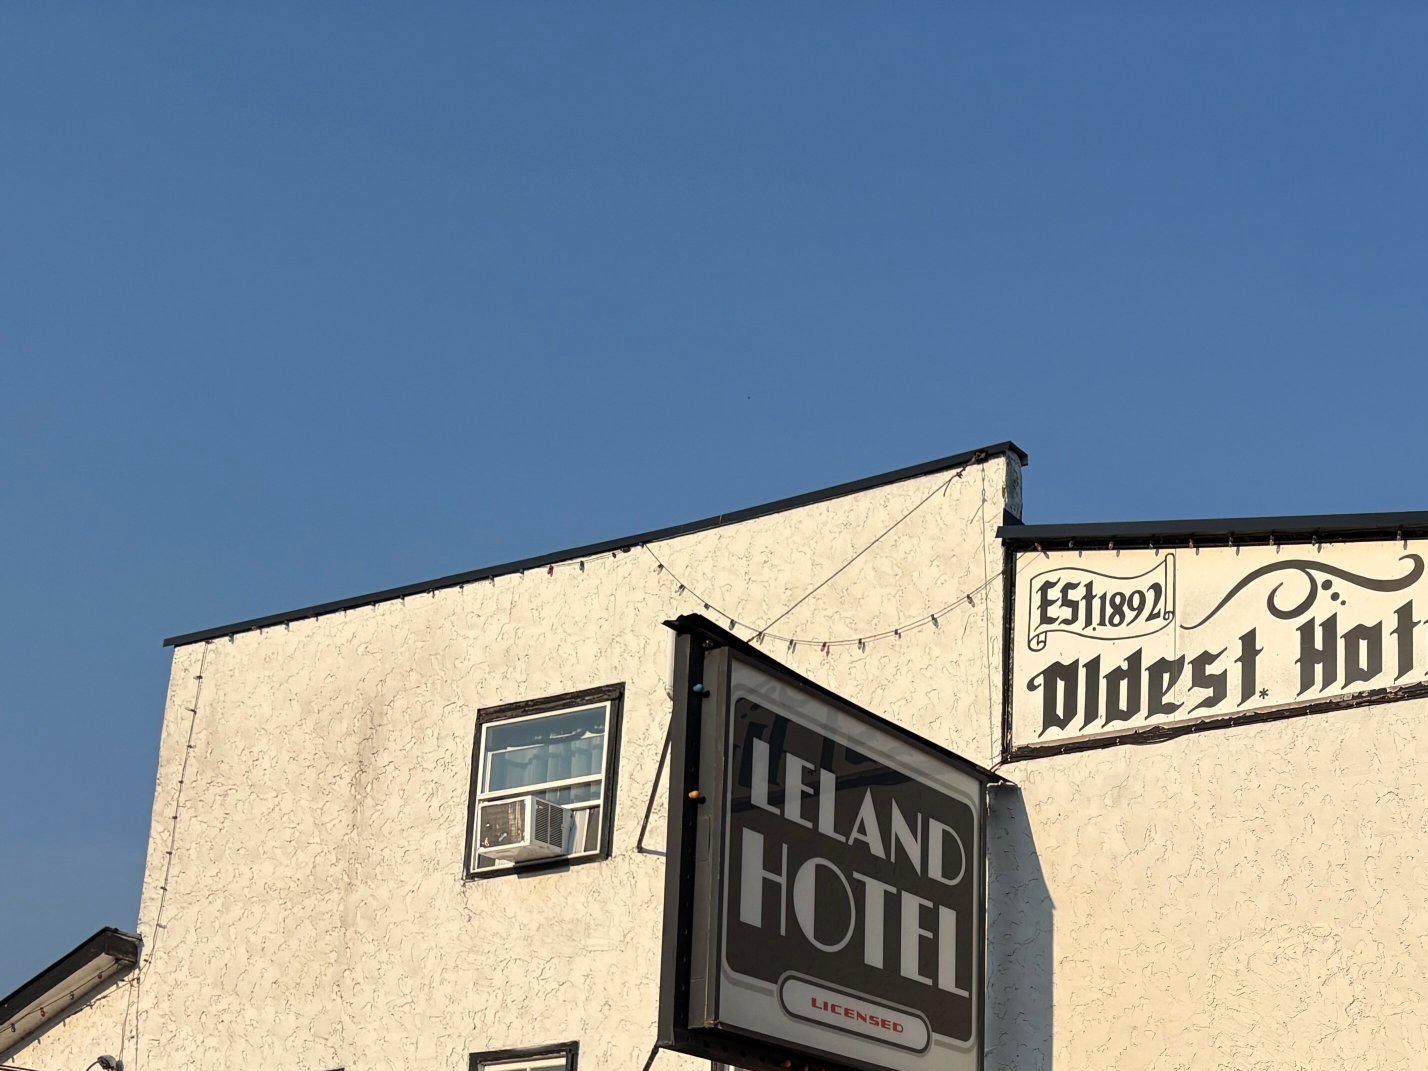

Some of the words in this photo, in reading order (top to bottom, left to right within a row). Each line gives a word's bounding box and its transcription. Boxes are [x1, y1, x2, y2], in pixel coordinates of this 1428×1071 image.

[750, 736, 966, 887] LELAND
[739, 826, 970, 998] HOTEL
[811, 997, 904, 1033] LICENSED
